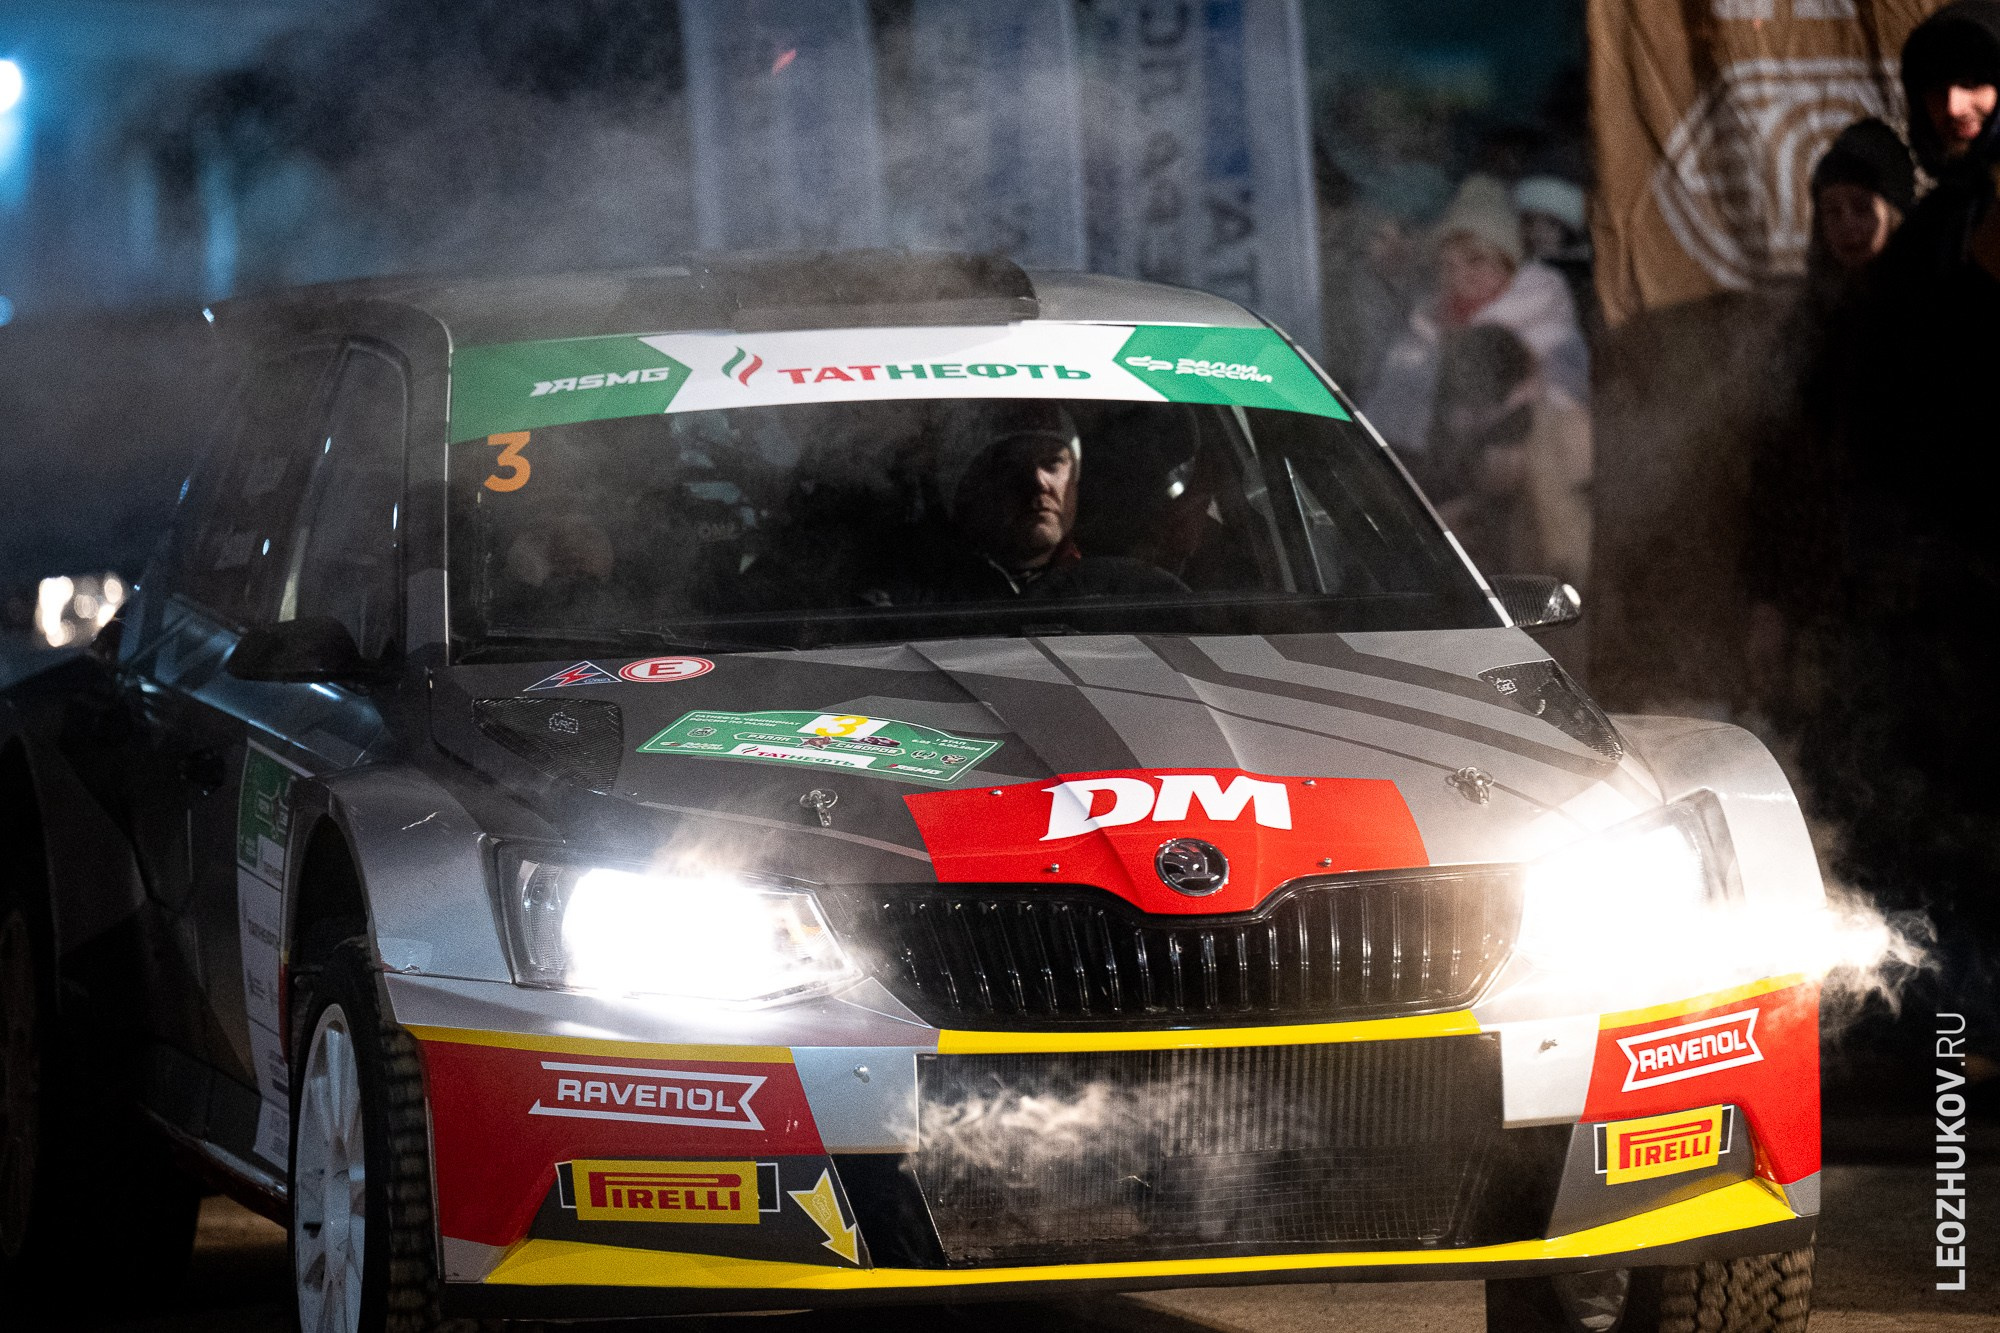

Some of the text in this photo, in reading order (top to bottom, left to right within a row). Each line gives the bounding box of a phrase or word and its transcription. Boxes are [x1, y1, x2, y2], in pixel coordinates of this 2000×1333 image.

[777, 363, 1092, 384] ТАТНЕФТЬ
[1175, 366, 1273, 383] РОССИИ
[484, 431, 531, 492] 3
[648, 661, 684, 677] E
[815, 715, 869, 737] 3
[758, 751, 855, 766] ТАТНЕФТЬ
[836, 742, 899, 754] СУВОРОВ
[1038, 774, 1293, 841] DM
[1638, 1028, 1748, 1072] RAVENOL
[557, 1078, 736, 1113] RAVENOL
[1619, 1118, 1713, 1170] PIRELLI
[588, 1171, 742, 1211] PIRELLI
